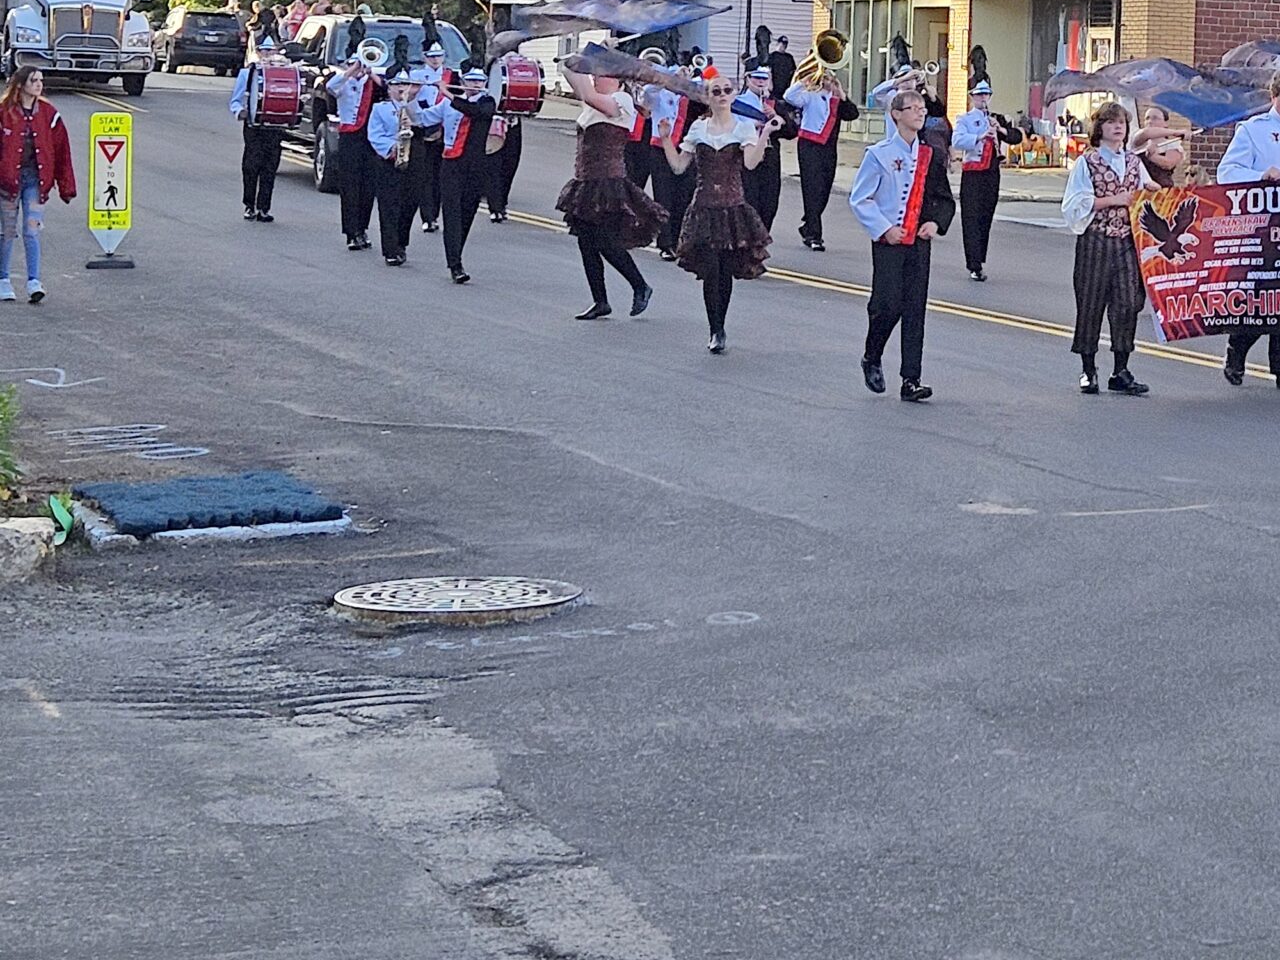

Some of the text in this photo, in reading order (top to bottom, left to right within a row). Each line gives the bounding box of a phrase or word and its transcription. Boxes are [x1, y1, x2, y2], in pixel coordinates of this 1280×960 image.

[99, 116, 124, 125] STATE
[1202, 315, 1240, 327] Would
[1243, 314, 1264, 326] like
[1266, 315, 1278, 326] to
